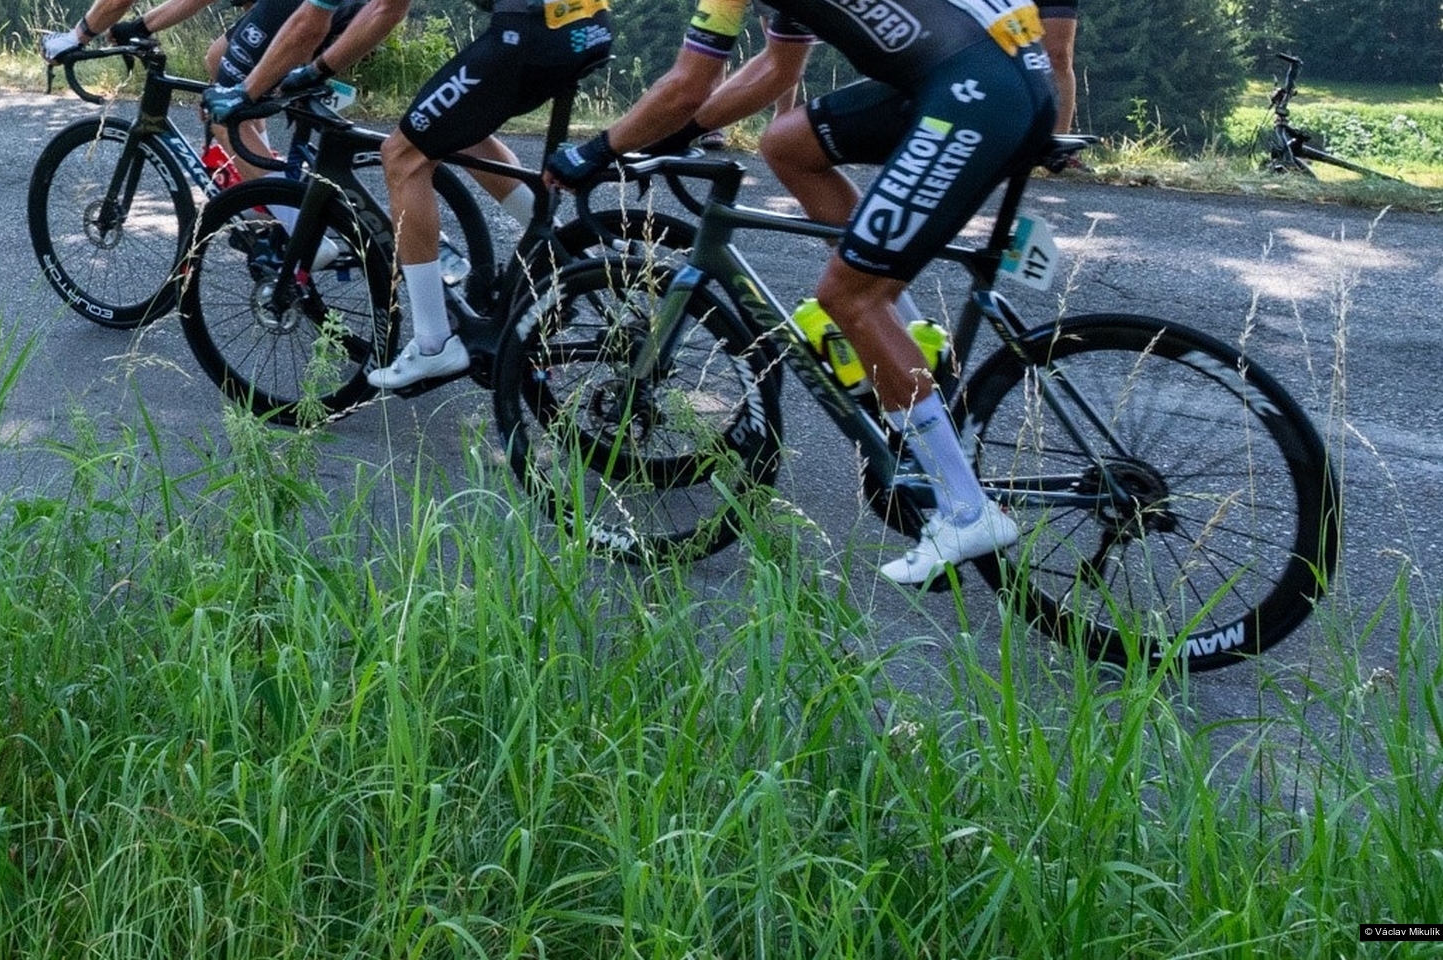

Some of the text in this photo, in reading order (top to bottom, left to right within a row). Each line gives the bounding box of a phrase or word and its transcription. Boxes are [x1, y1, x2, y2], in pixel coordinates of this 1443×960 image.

[418, 65, 481, 117] TDK
[878, 116, 954, 200] ELKOV
[910, 129, 983, 209] ELEKTRO
[43, 254, 114, 319] EQUATOR
[1022, 246, 1050, 279] 117
[1153, 621, 1245, 658] MAV
